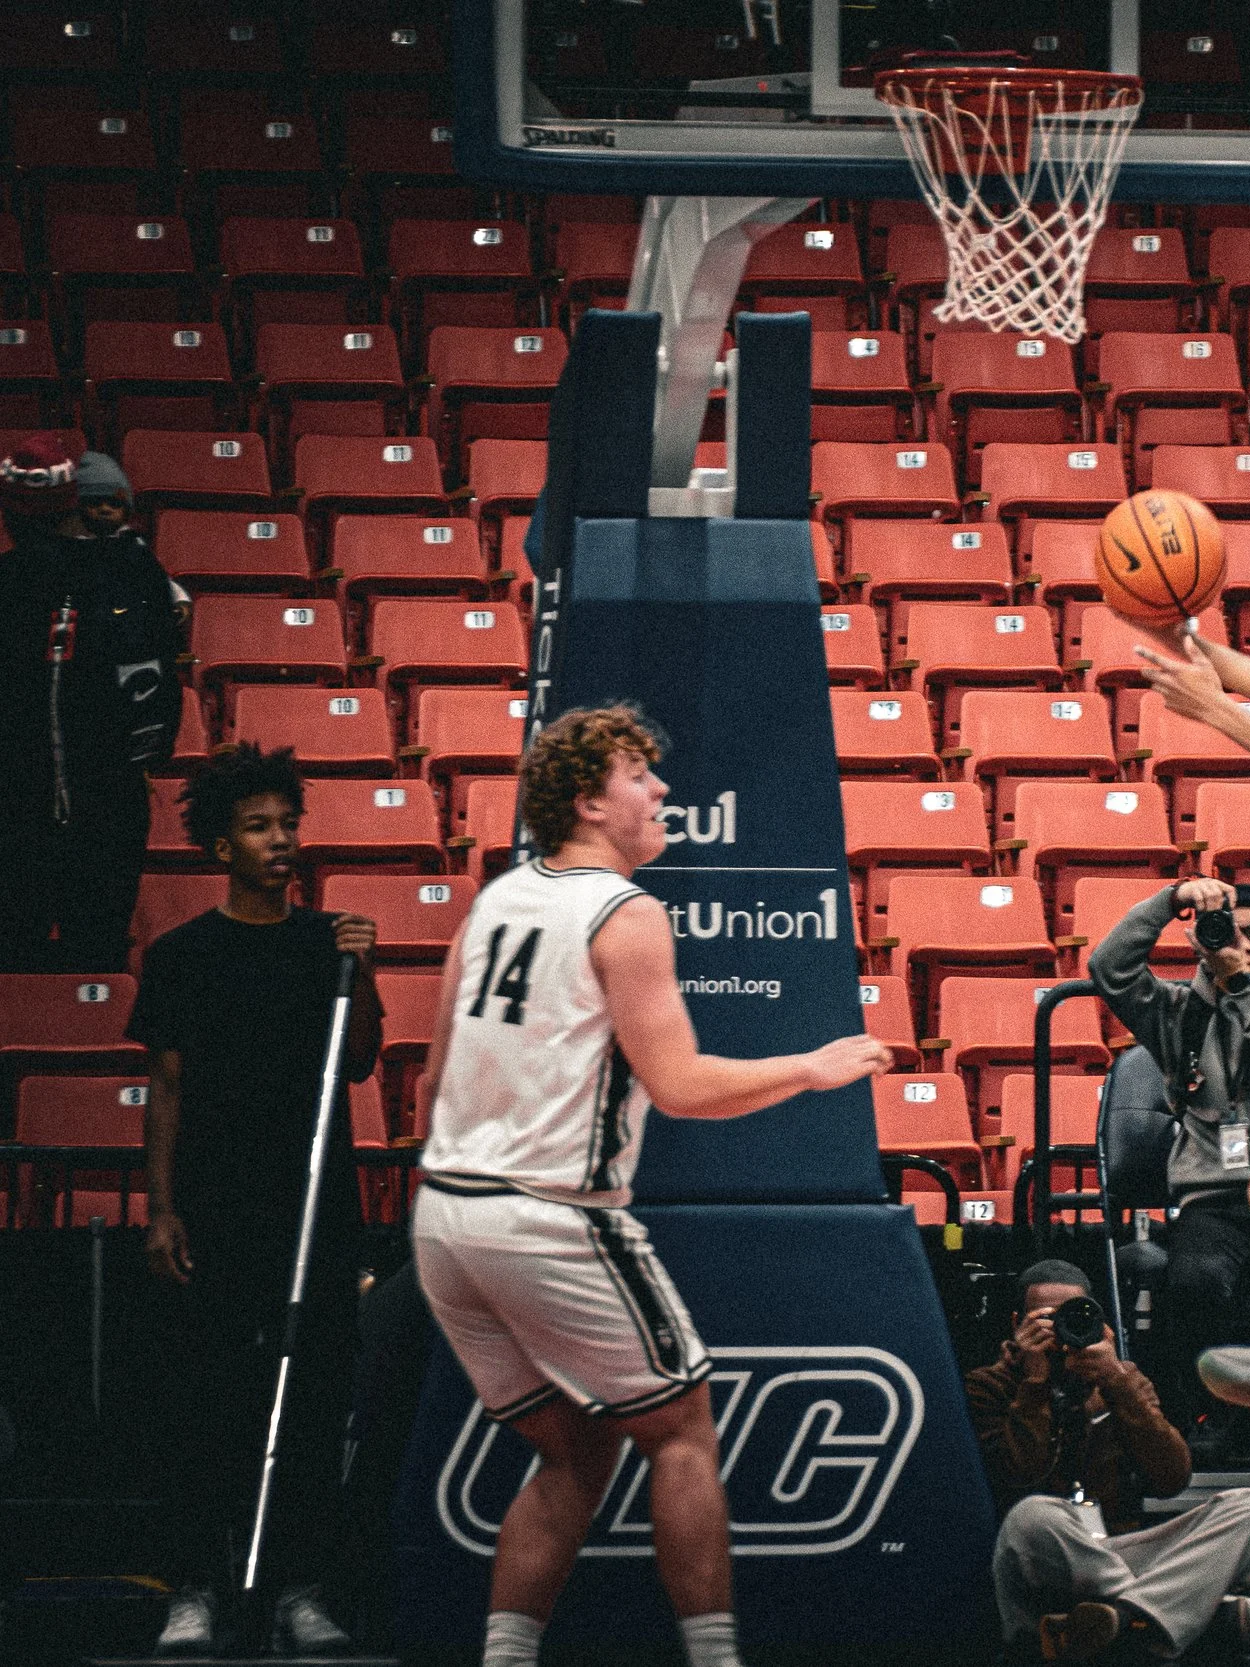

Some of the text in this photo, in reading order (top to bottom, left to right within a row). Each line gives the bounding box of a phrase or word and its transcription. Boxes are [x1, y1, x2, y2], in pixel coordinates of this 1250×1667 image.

[522, 127, 615, 147] SPALDING
[1024, 341, 1037, 355] 15
[1190, 343, 1204, 356] 16
[220, 442, 234, 455] 10
[393, 447, 404, 460] 11
[904, 453, 918, 467] 14
[432, 528, 445, 542] 11
[961, 533, 974, 547] 14
[474, 613, 486, 627] 11
[1002, 617, 1018, 631] 14
[337, 699, 351, 713] 10
[428, 887, 443, 901] 10
[661, 888, 838, 940] tUnion1
[467, 923, 544, 1026] 14
[912, 1086, 929, 1101] 12
[971, 1203, 988, 1219] 12
[880, 1541, 906, 1553] TM
